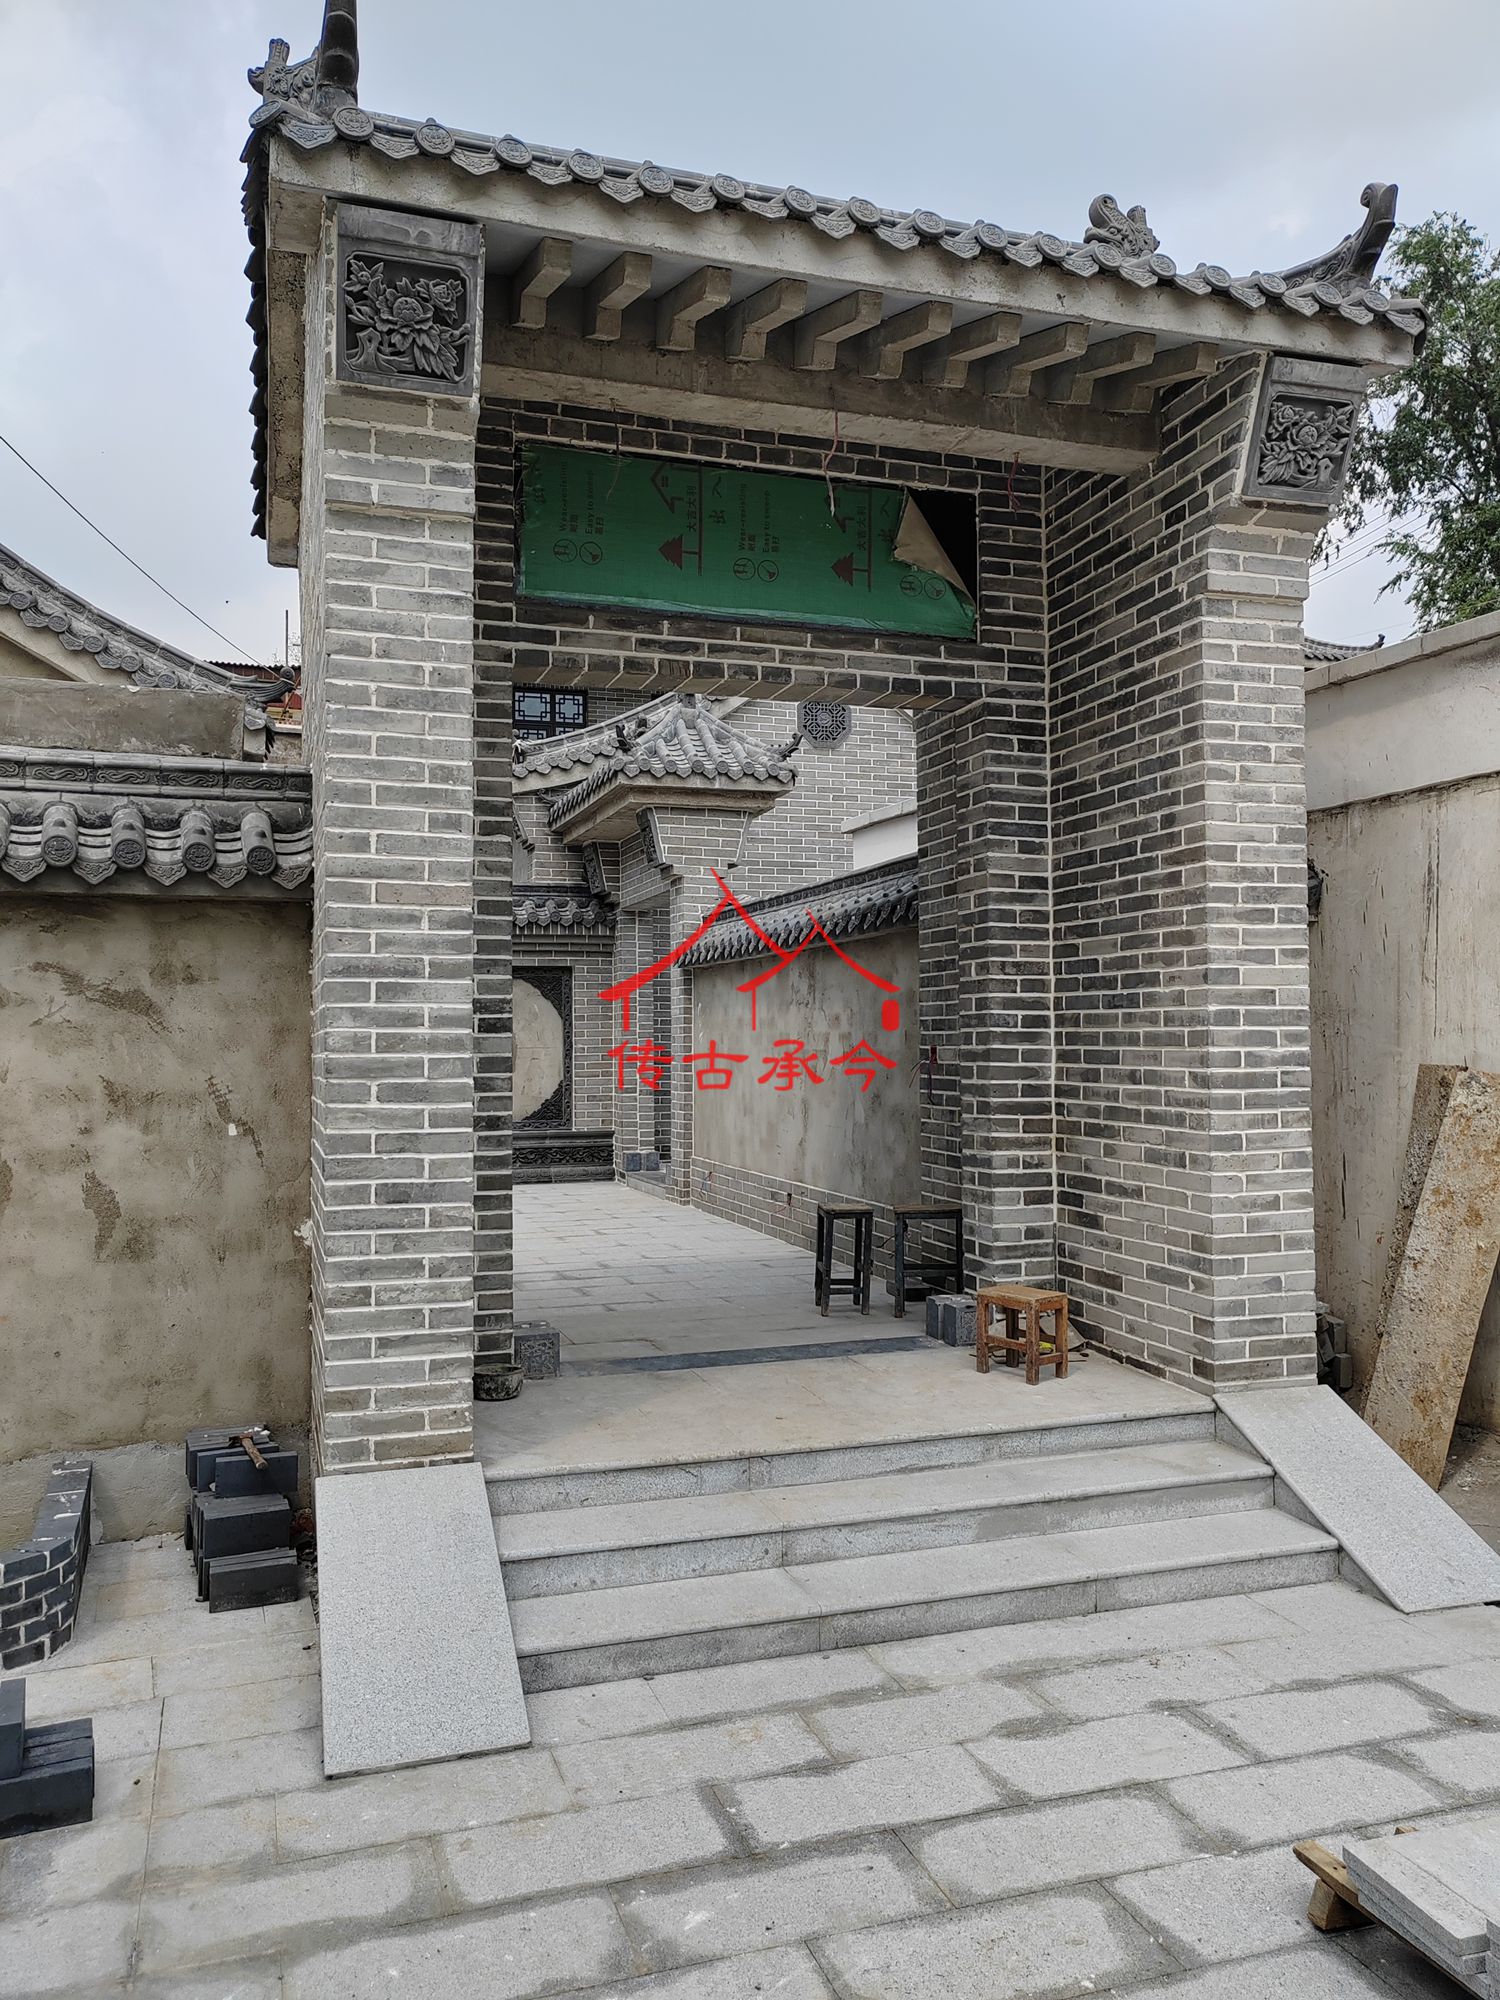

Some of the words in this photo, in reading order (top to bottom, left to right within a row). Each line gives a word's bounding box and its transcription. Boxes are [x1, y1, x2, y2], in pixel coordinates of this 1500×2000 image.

[585, 512, 594, 535] Easy
[686, 485, 697, 533] 大吉大利
[762, 532, 771, 553] Easy
[856, 505, 867, 552] 大吉大利
